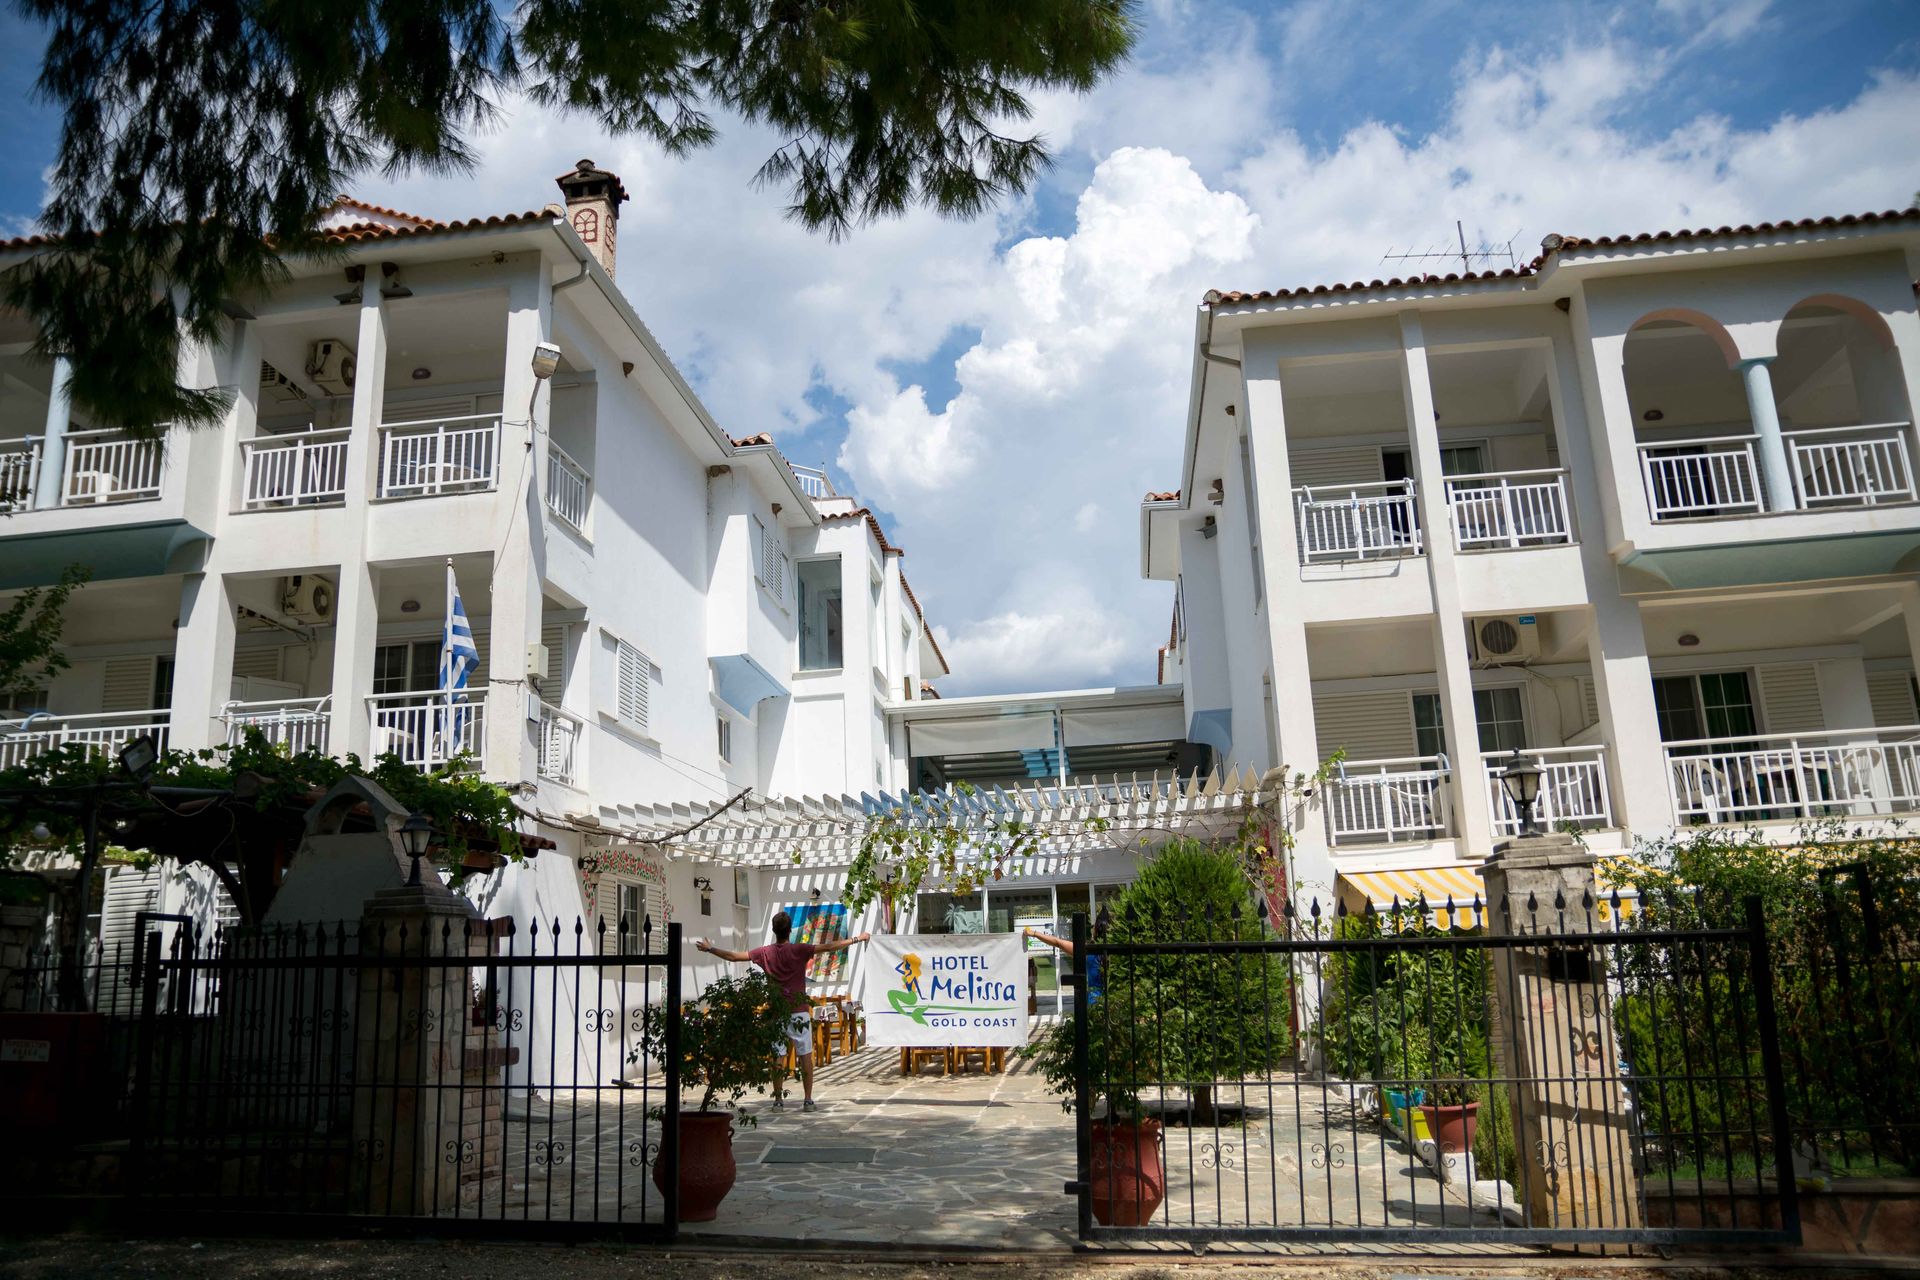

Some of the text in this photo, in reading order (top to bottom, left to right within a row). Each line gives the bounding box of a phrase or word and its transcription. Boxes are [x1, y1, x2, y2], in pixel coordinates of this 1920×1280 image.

[932, 956, 988, 970] HOTEL
[931, 972, 1016, 1004] Melissa
[931, 1018, 1017, 1027] GOLD COAST
